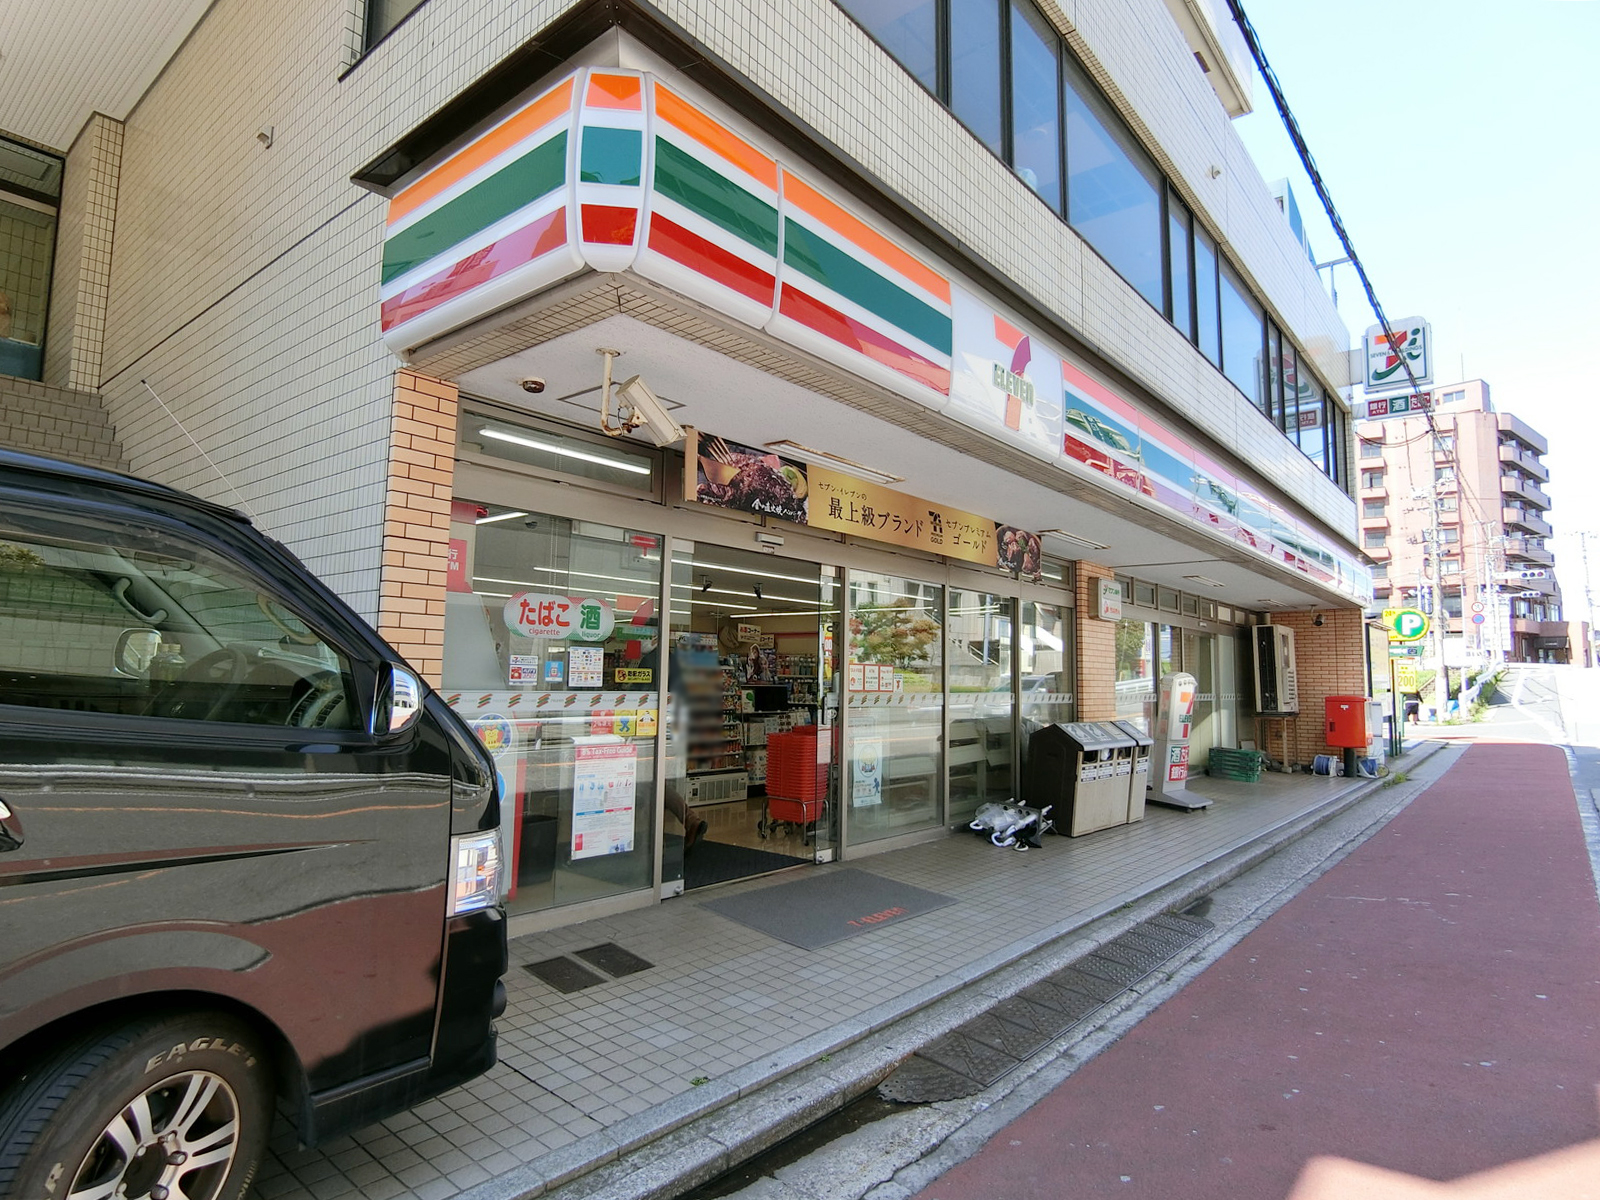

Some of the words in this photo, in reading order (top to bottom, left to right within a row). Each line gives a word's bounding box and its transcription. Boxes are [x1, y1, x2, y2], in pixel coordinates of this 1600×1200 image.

[1391, 398, 1407, 412] 酒
[828, 496, 924, 538] 最上級ブランド
[945, 519, 992, 539] セブンプレミアム
[929, 536, 944, 545] GOLD
[952, 533, 987, 554] ゴールド
[519, 598, 570, 627] たばこ
[580, 604, 602, 631] 酒
[528, 627, 560, 636] cigarette
[581, 630, 601, 639] liquor
[1401, 613, 1422, 636] P
[1398, 675, 1414, 687] 200
[1171, 747, 1181, 763] 酒
[1170, 766, 1185, 779] 銀行
[144, 1036, 248, 1075] EAGLE
